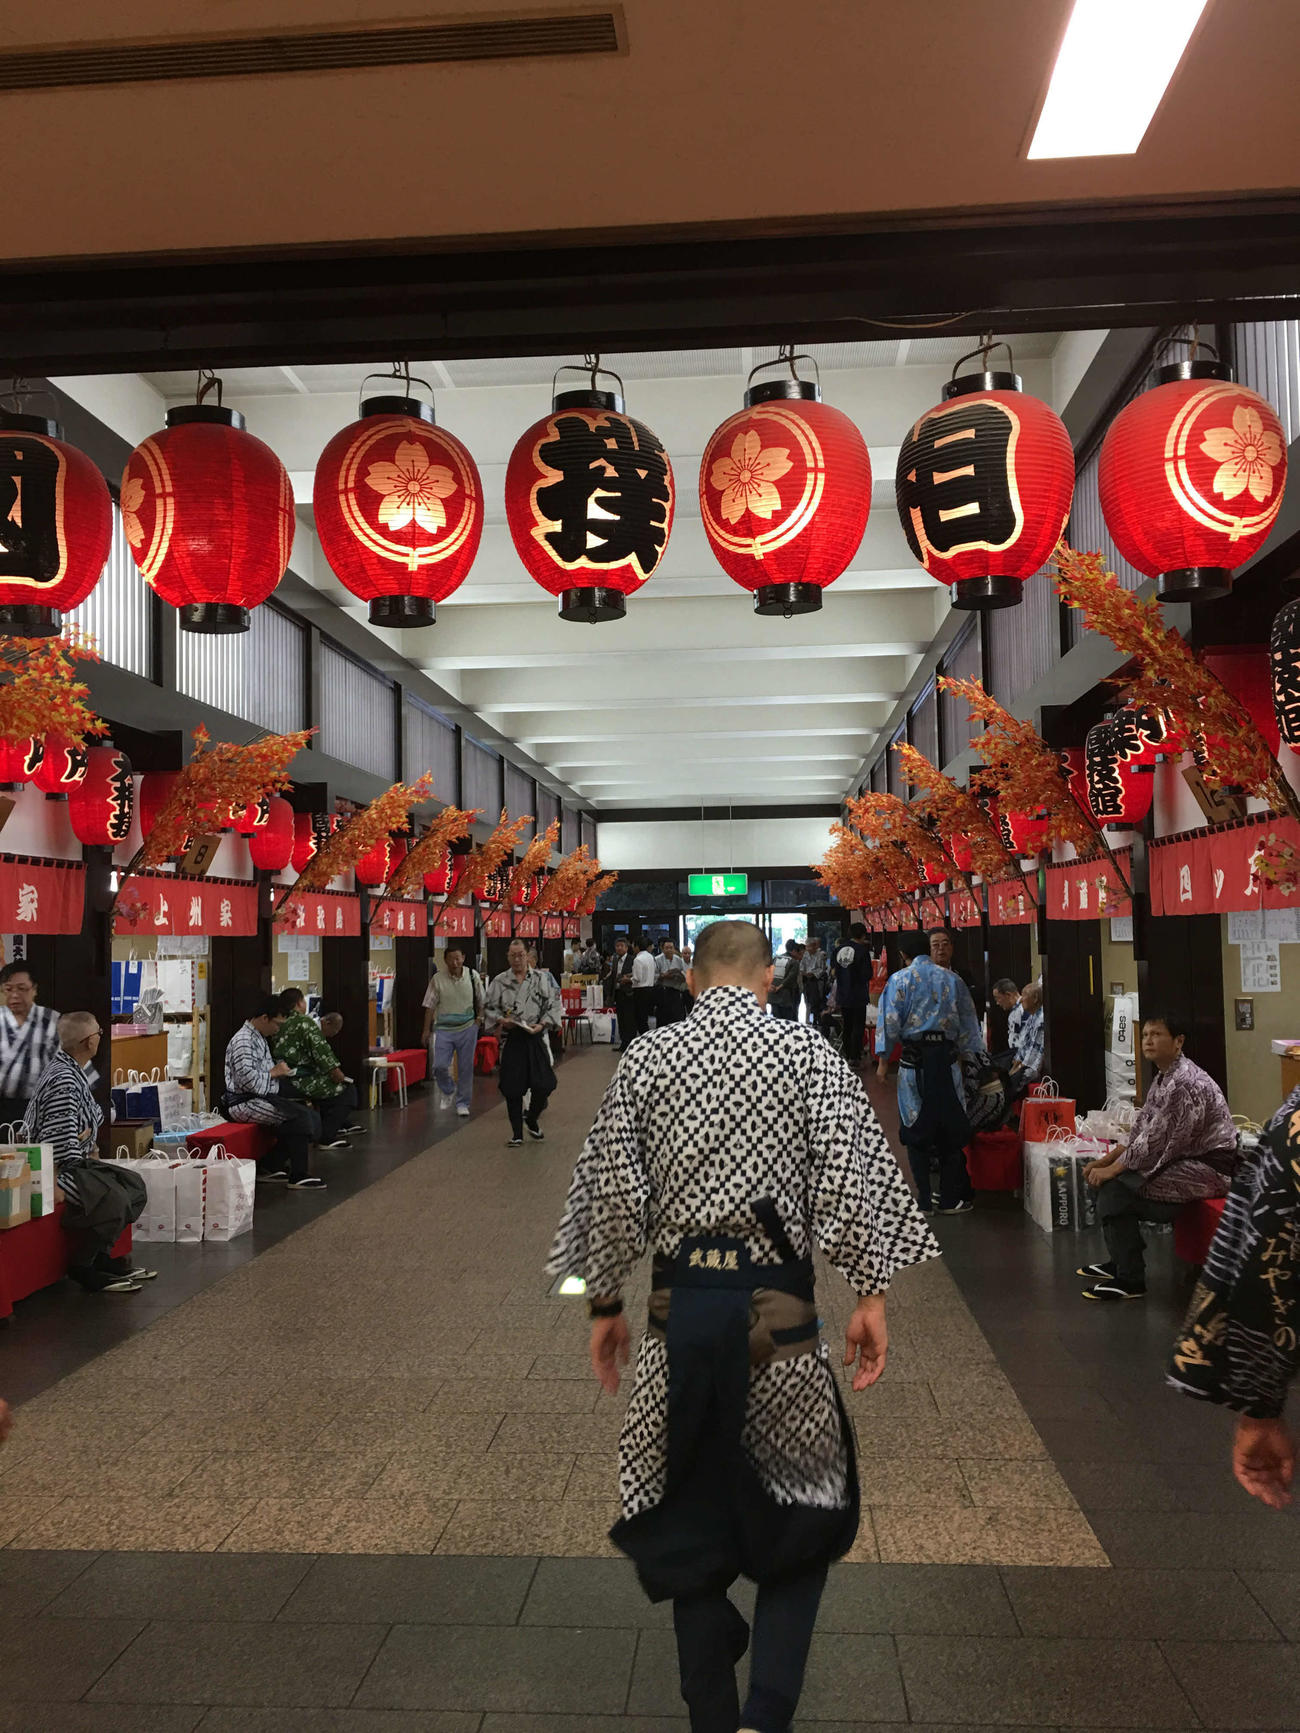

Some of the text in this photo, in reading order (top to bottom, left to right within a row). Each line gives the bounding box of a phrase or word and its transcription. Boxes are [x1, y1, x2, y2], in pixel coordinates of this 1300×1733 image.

[154, 893, 233, 928] 上州家
[1057, 1181, 1069, 1226] SAPPORO
